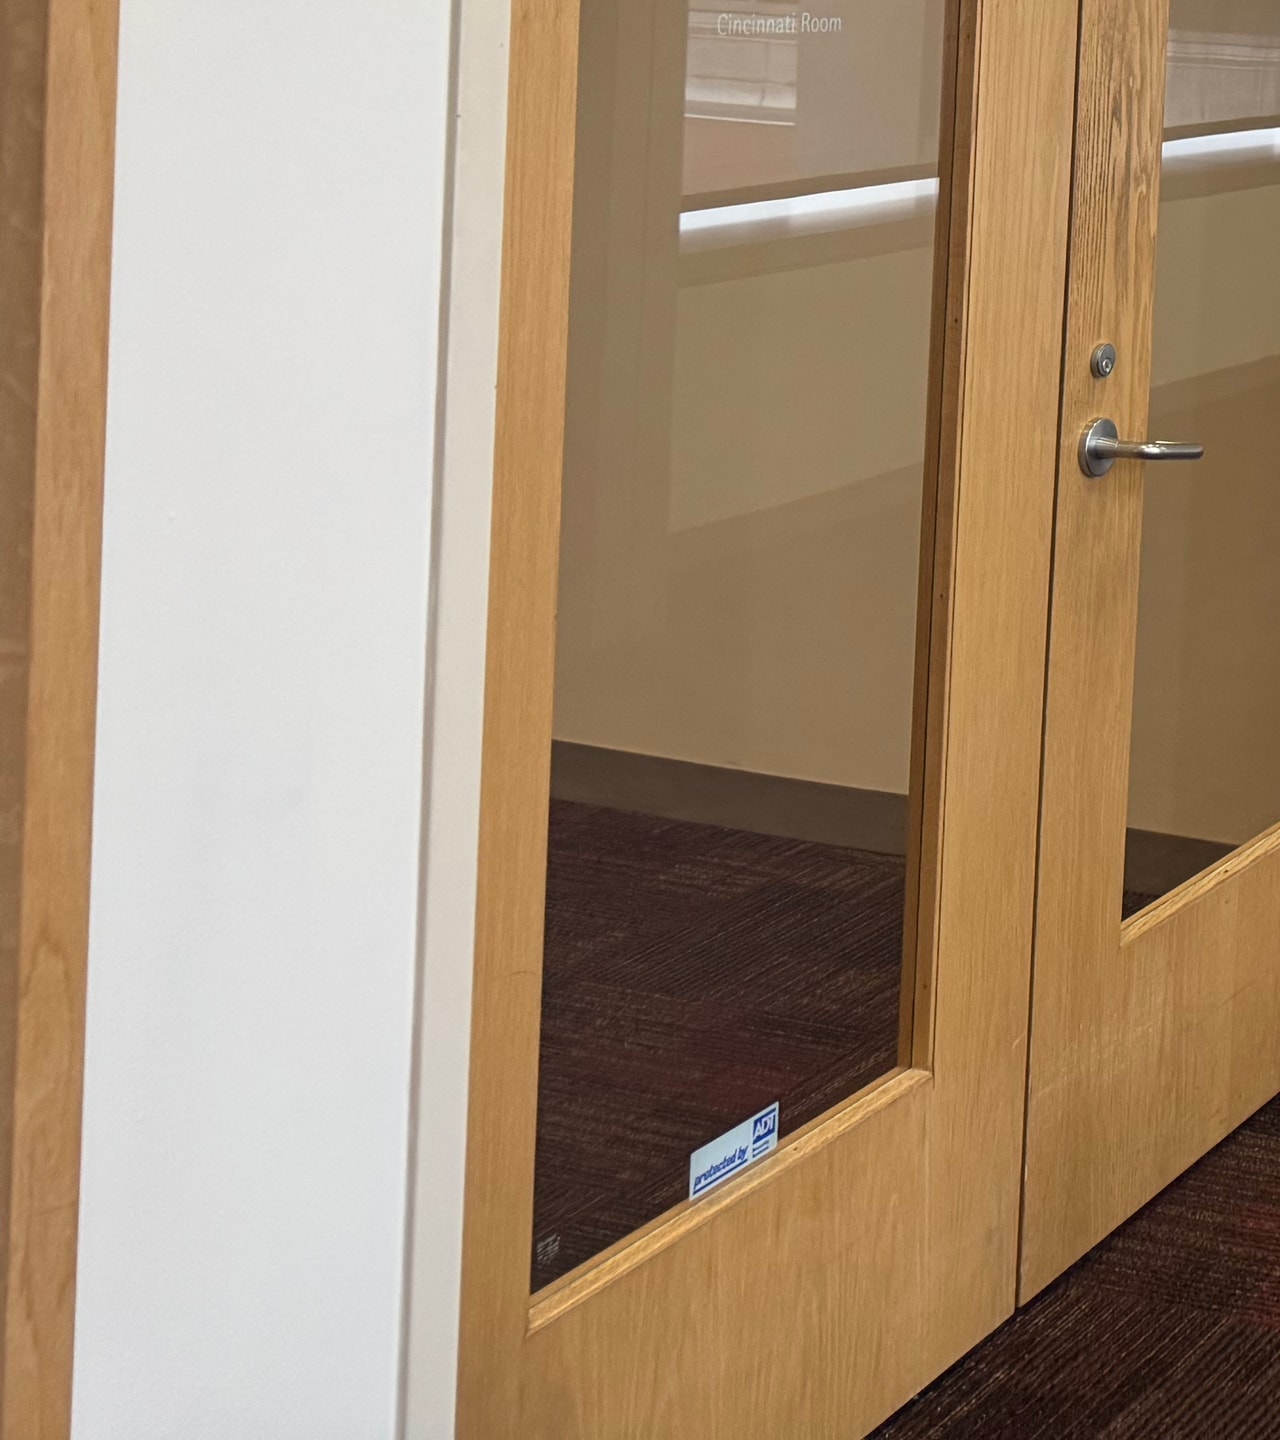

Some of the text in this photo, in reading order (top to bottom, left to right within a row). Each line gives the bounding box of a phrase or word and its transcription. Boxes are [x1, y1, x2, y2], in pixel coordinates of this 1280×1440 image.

[717, 12, 842, 36] Cincinnati Room
[753, 1114, 775, 1138] ADT
[694, 1148, 737, 1191] protected
[738, 1145, 748, 1160] by
